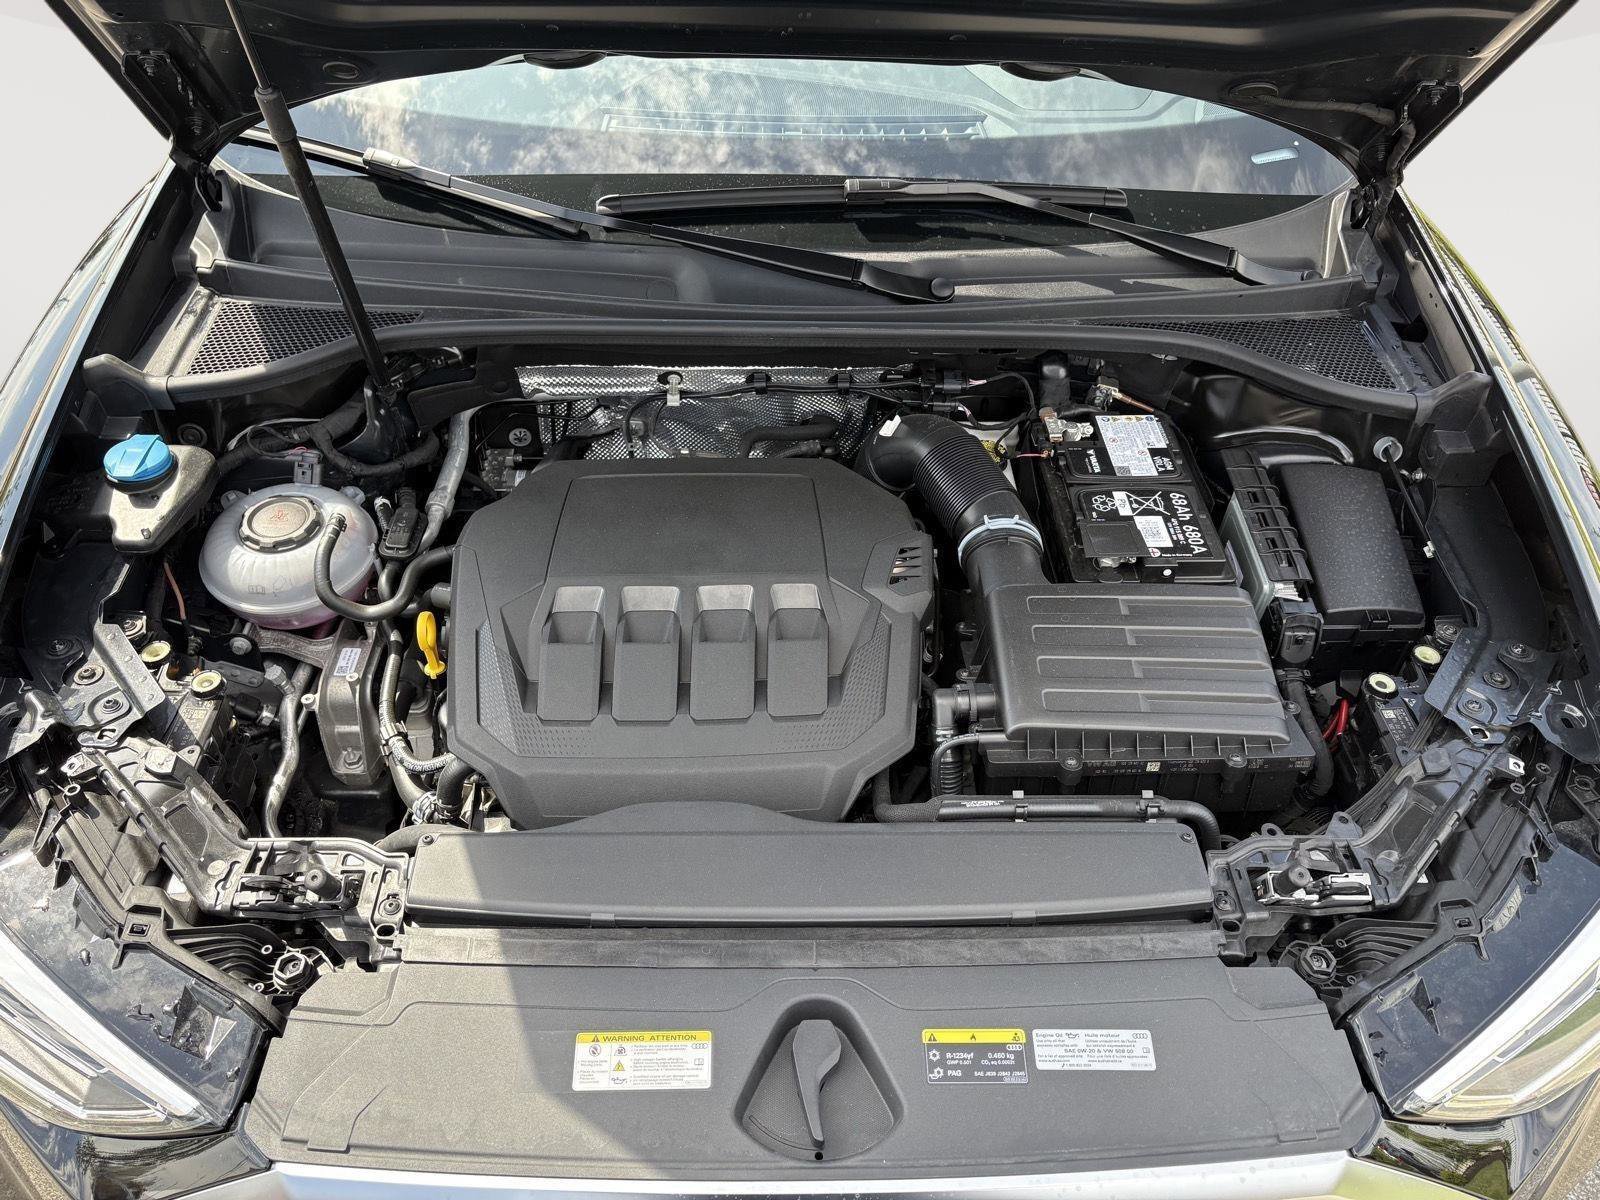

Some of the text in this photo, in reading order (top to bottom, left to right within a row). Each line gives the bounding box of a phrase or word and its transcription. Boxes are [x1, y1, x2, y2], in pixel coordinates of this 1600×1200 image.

[1089, 453, 1101, 473] VARTA
[1161, 457, 1175, 470] AGM
[1169, 493, 1194, 521] 68Ah
[1182, 525, 1208, 554] 680A
[945, 1052, 974, 1060] R-1234yf
[1006, 1052, 1015, 1060] kg
[947, 1069, 962, 1077] PAG
